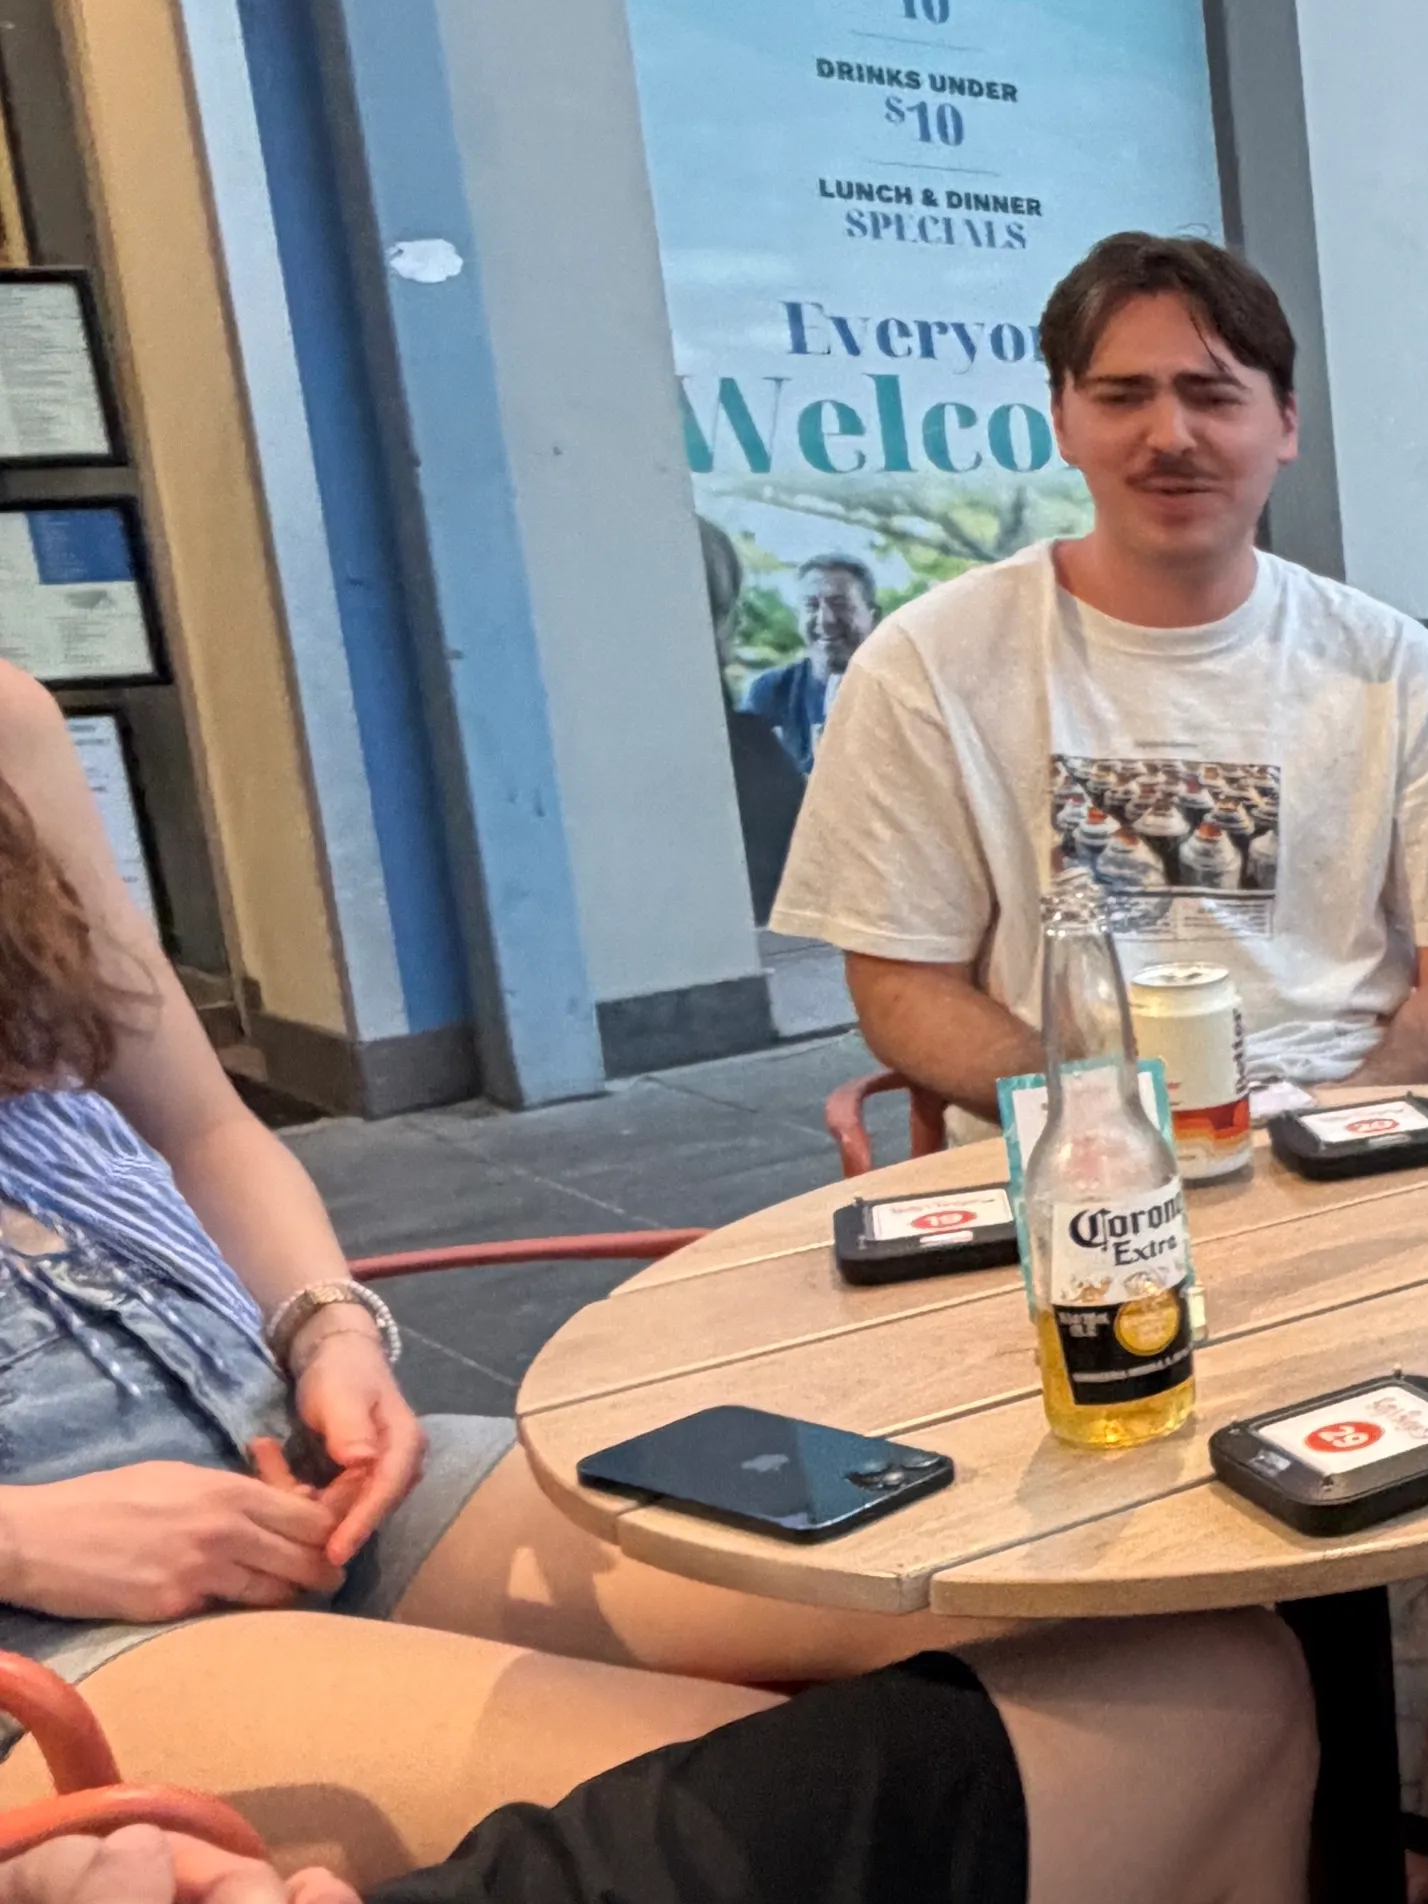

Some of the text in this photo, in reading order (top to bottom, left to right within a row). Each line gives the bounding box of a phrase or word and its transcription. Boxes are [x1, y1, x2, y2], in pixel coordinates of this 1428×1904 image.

[815, 57, 1019, 104] DRINKS UNDER
[884, 96, 965, 148] $10
[817, 176, 1043, 218] LUNCH & DINNER
[845, 208, 1028, 251] SPECIALS
[779, 300, 1044, 375] Everyo
[678, 373, 1062, 474] Welco
[1114, 1234, 1178, 1267] Extra
[1317, 1425, 1370, 1449] 29
